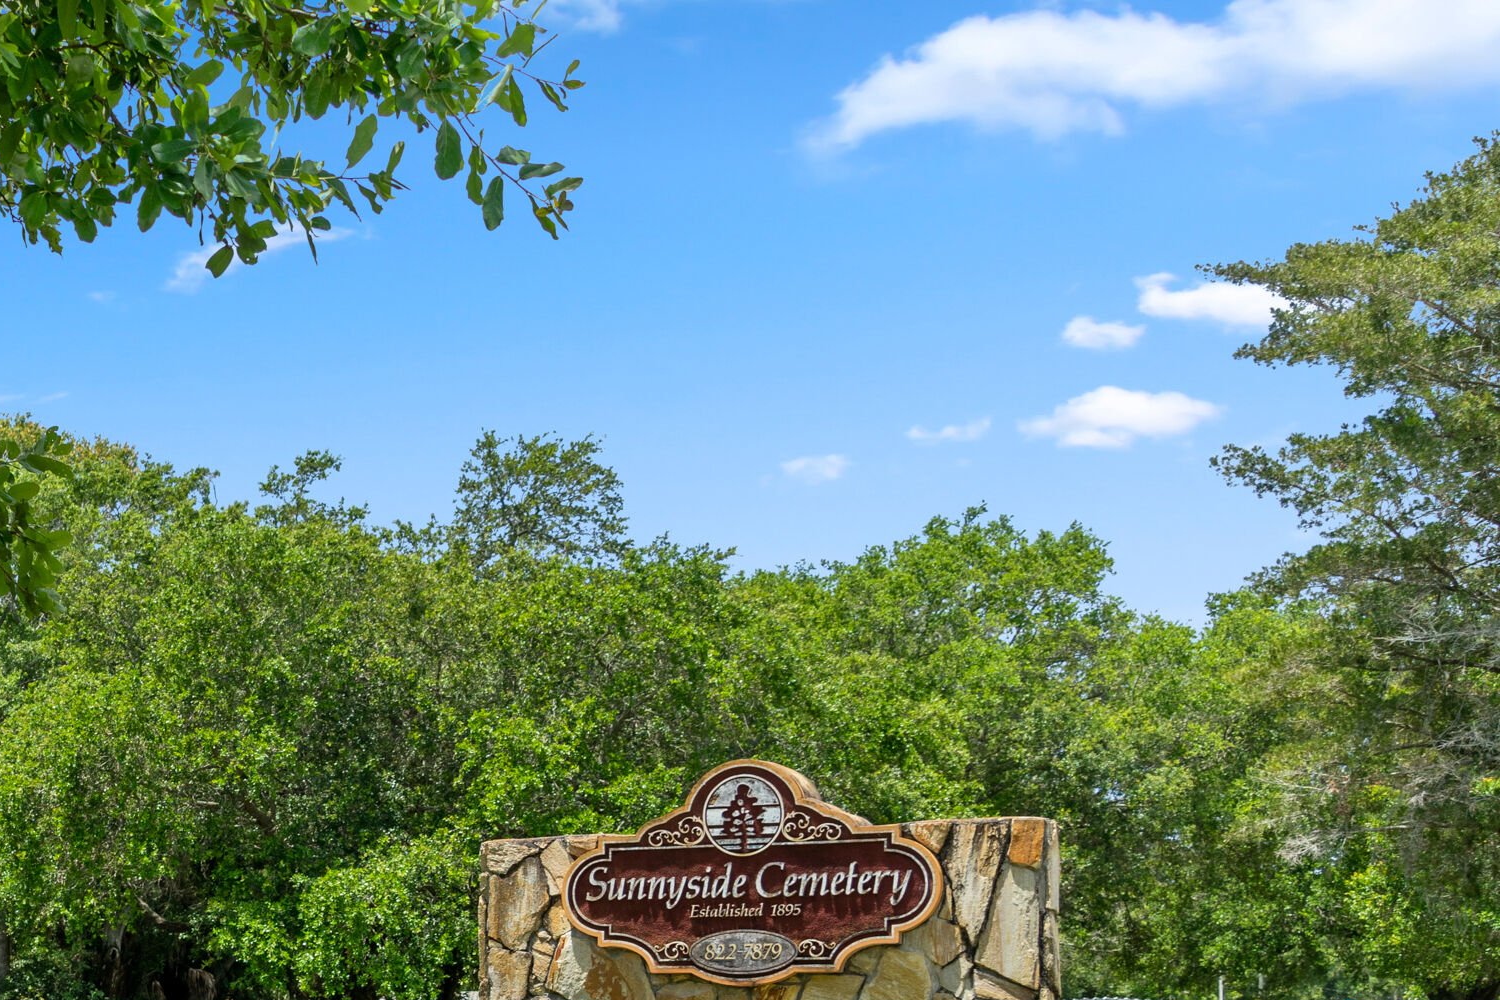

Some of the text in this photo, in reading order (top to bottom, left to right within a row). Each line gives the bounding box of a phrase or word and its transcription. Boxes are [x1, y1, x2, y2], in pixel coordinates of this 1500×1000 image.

[586, 861, 913, 910] Sunnyside Cemetery
[690, 902, 802, 918] Established 1895
[704, 942, 783, 961] 822-7879
